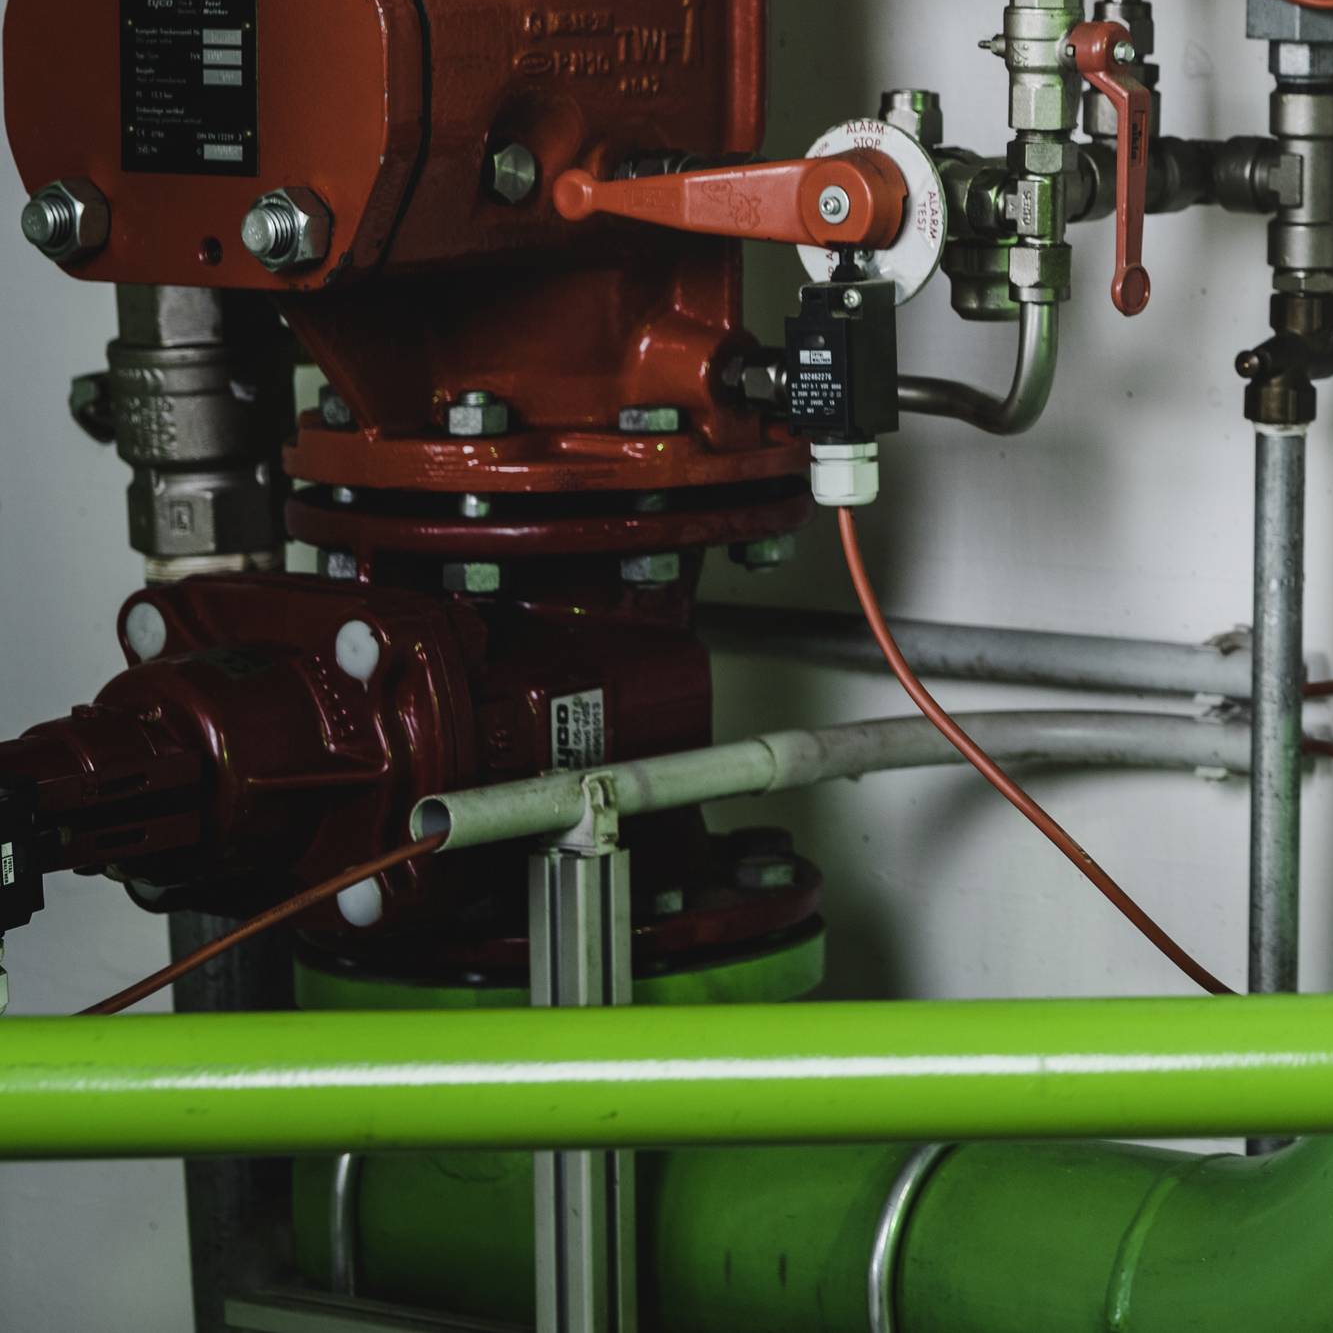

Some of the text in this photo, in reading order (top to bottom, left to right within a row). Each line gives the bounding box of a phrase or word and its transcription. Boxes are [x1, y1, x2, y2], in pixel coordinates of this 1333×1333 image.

[846, 121, 885, 136] ALARM
[853, 137, 881, 150] STOP
[916, 202, 928, 234] TEST
